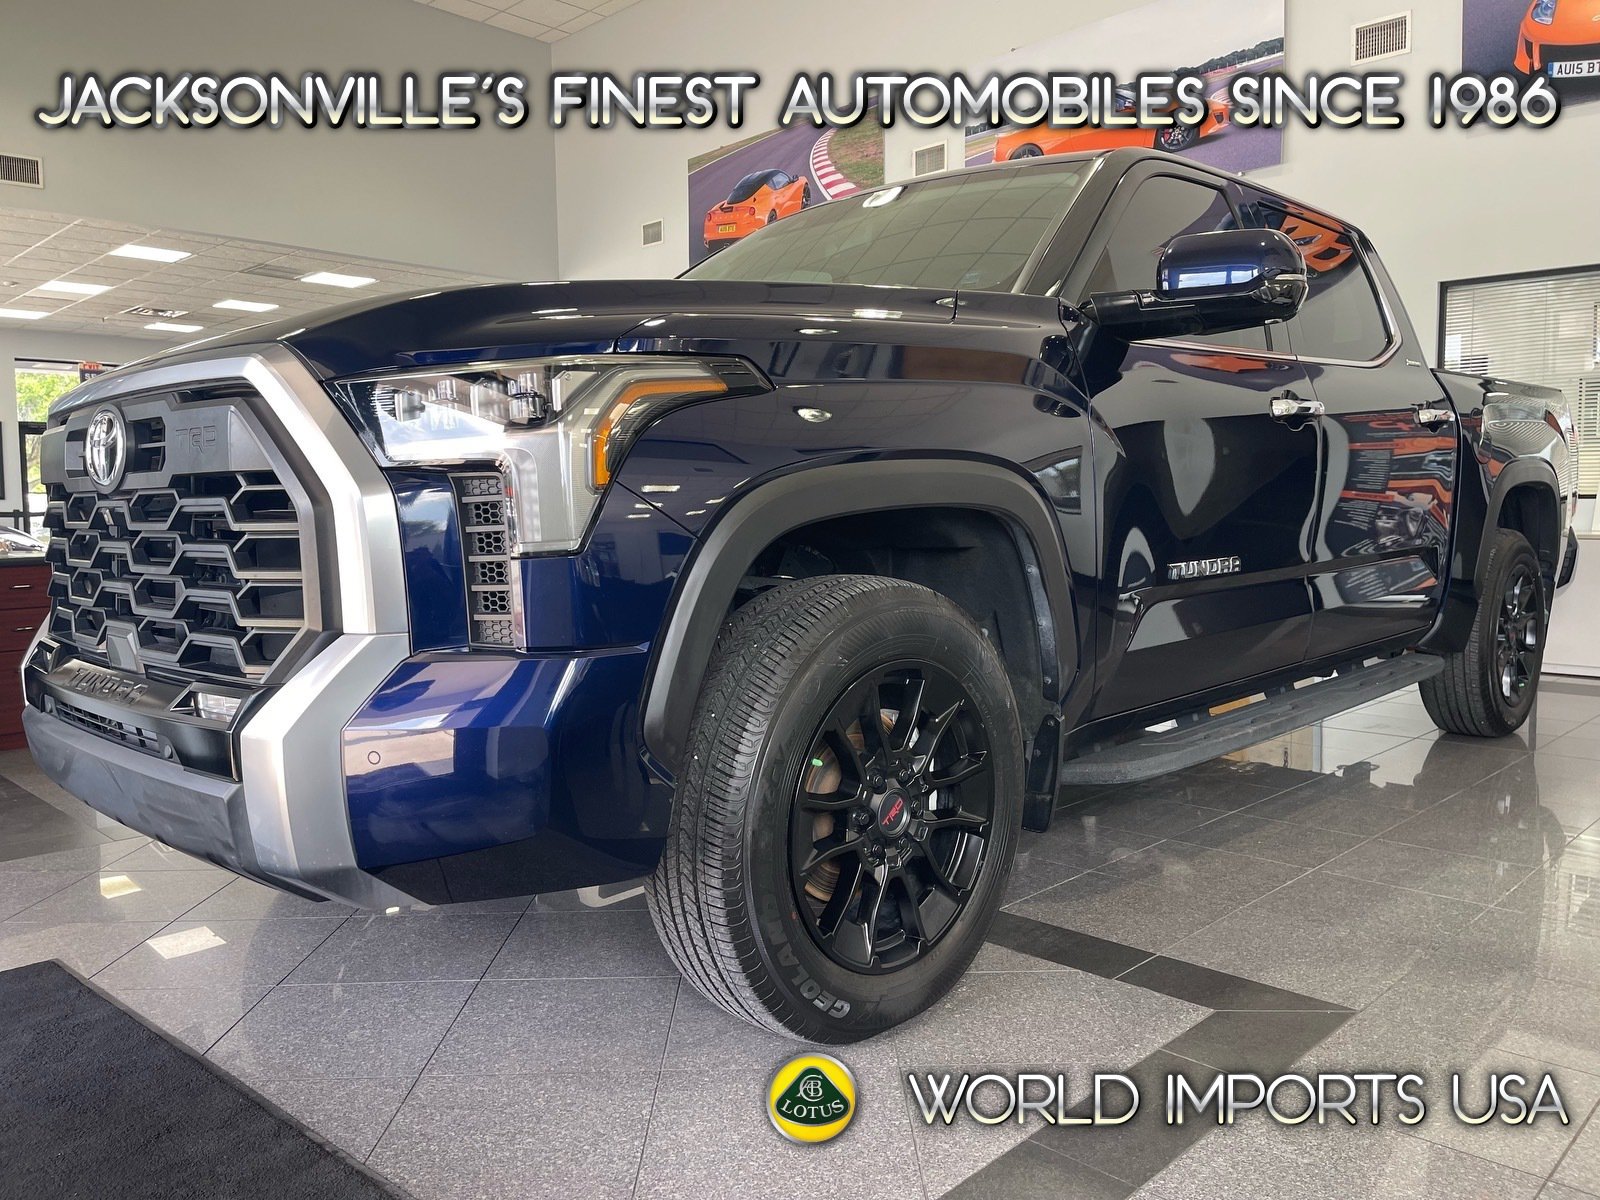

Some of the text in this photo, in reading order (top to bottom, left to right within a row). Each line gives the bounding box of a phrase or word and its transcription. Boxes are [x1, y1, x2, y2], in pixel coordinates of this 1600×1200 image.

[1167, 556, 1241, 580] TUNDRA
[66, 667, 149, 705] TUNDRA
[882, 797, 904, 825] TRD
